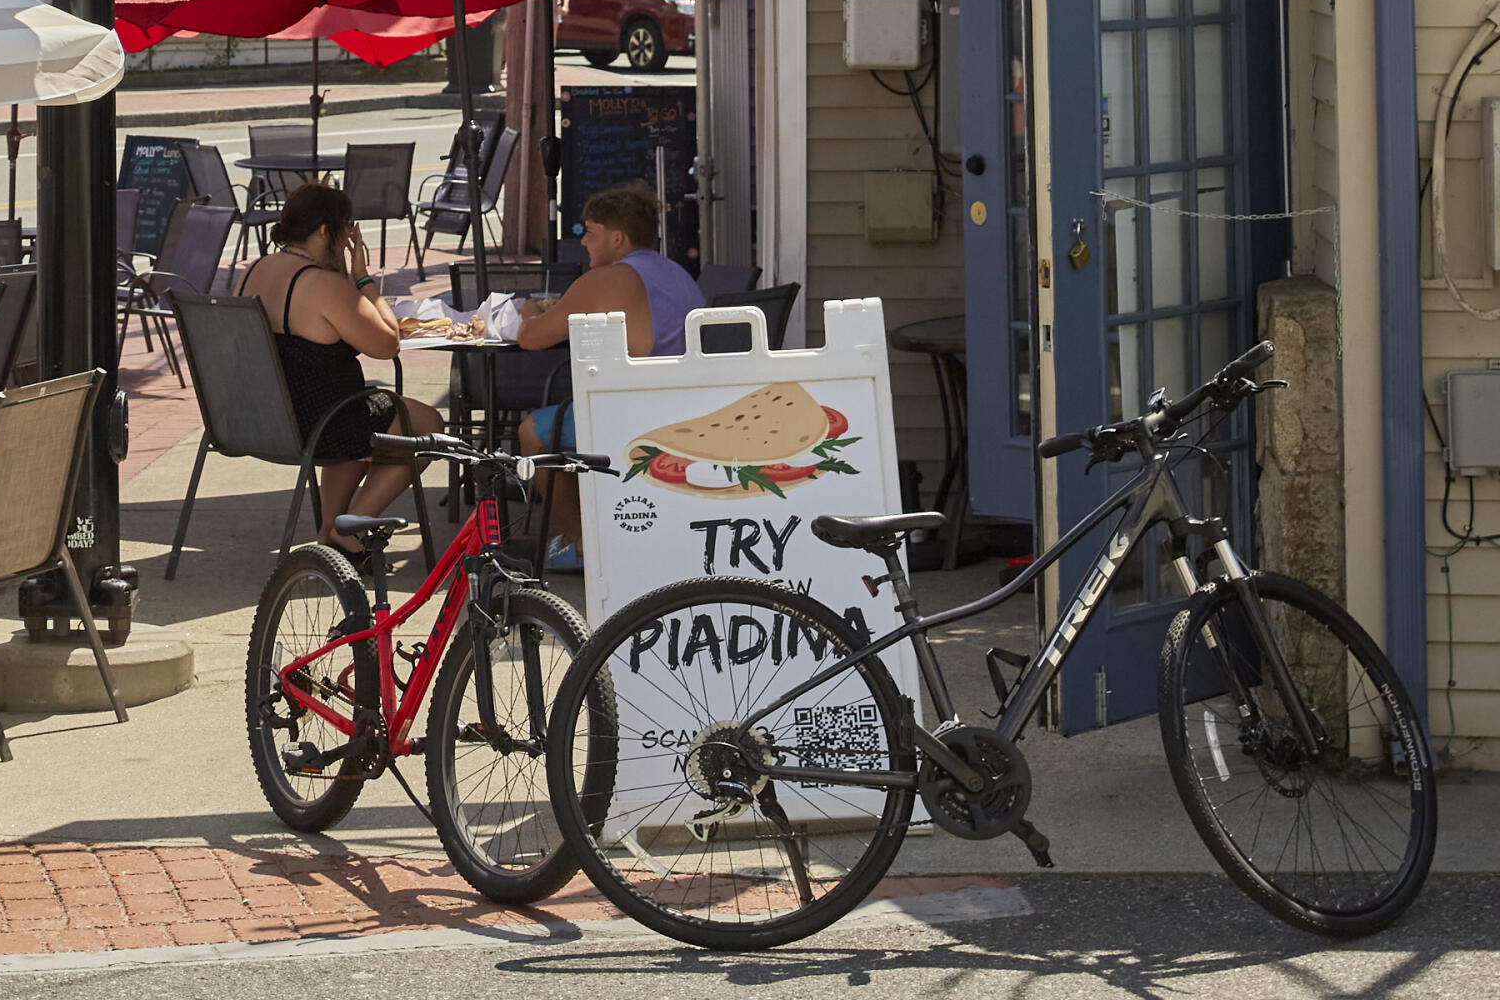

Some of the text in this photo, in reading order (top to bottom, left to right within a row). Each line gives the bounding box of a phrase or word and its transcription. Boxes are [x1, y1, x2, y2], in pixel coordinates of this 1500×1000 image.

[615, 496, 656, 511] ITALIAN
[613, 512, 658, 521] PIADINA
[619, 521, 654, 533] BREAD
[690, 515, 802, 575] TRY
[1037, 532, 1130, 669] TREK
[642, 729, 697, 748] SCA
